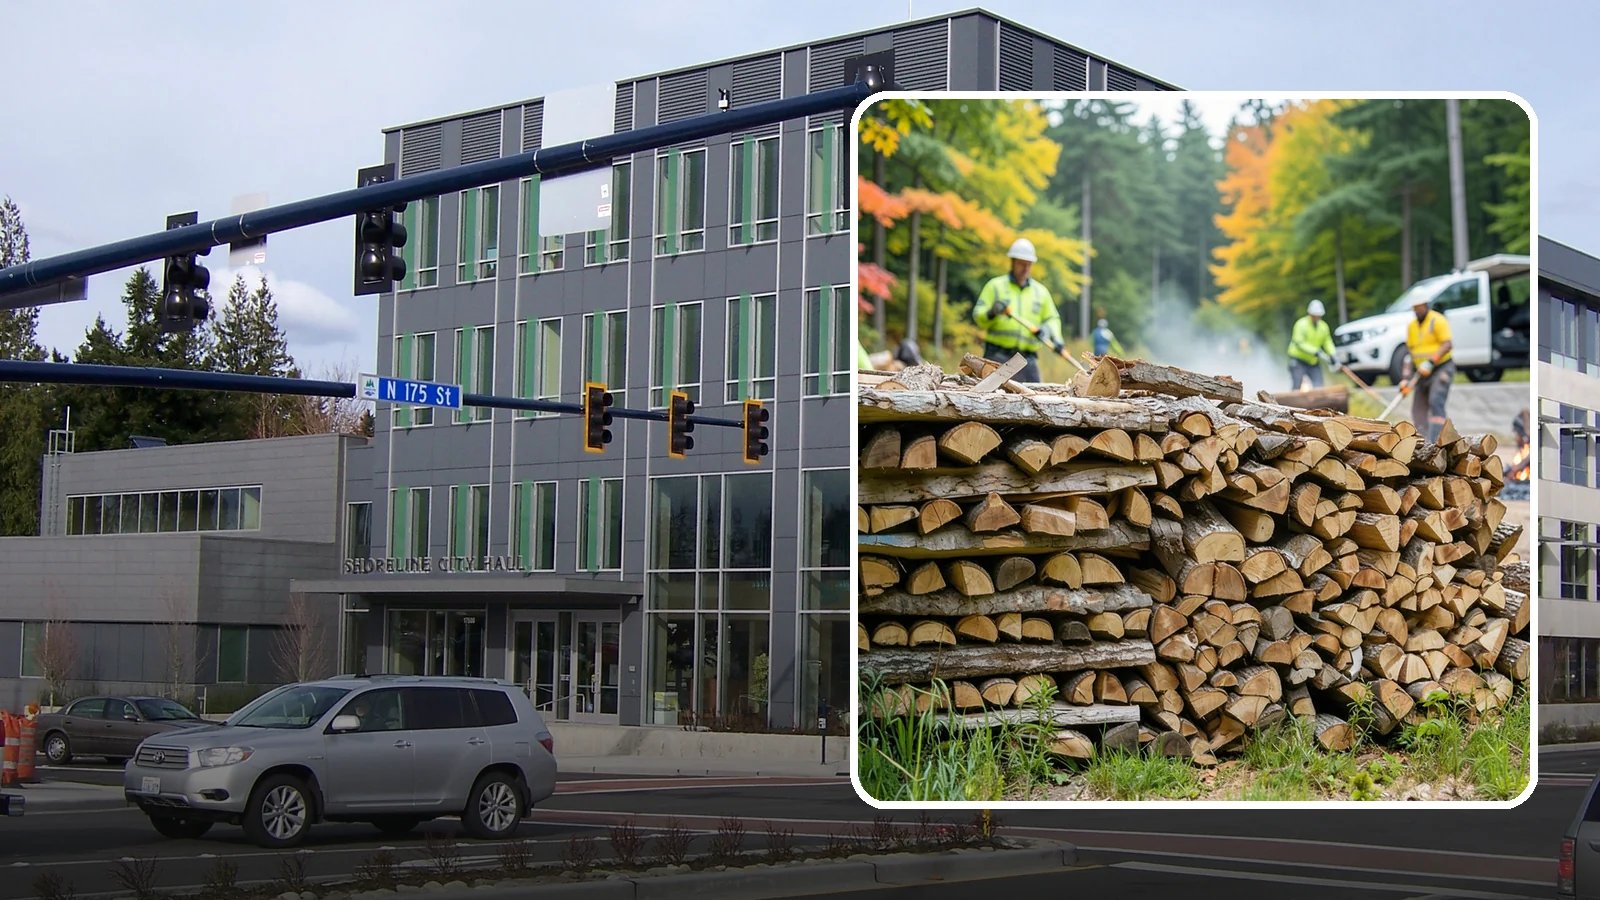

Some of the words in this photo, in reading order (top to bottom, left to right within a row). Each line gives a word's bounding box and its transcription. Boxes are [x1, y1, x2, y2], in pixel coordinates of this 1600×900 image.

[387, 380, 396, 399] N
[405, 382, 427, 403] 175
[436, 386, 451, 406] St
[343, 557, 432, 574] SHORELINE
[438, 556, 476, 572] CITY
[483, 556, 525, 572] HALL
